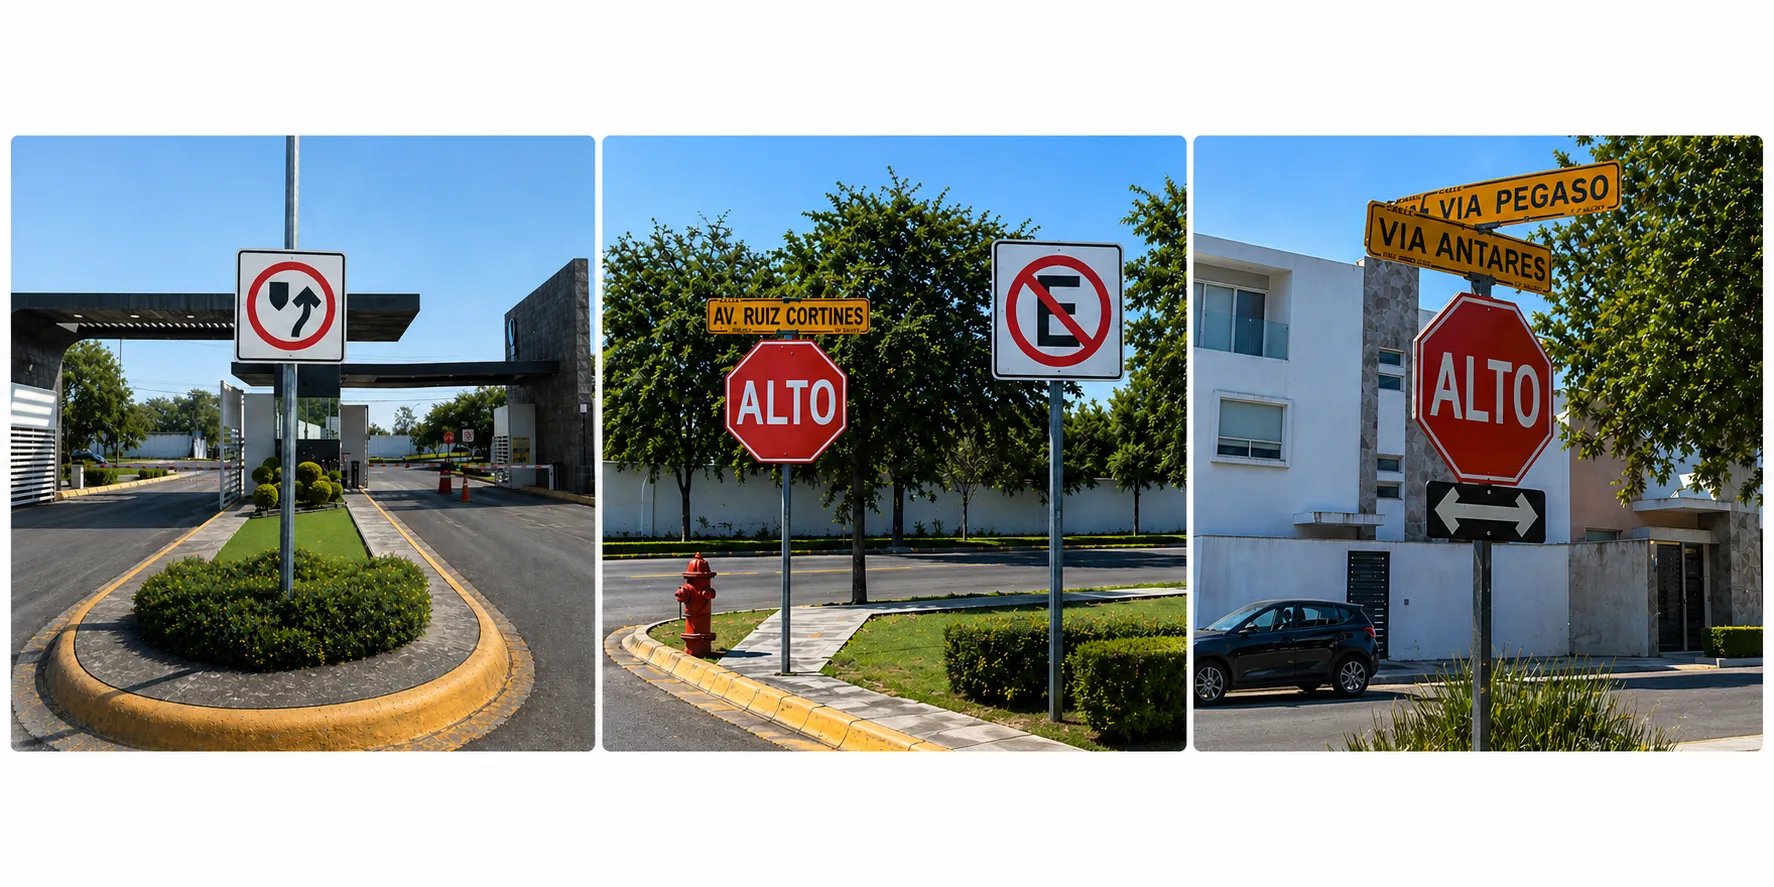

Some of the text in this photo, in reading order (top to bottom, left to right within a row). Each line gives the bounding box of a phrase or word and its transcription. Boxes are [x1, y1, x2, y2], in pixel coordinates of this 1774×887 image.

[1440, 175, 1609, 220] VIA PEGASO
[1379, 218, 1546, 282] VIA ANTARES
[714, 307, 864, 325] AV. RUIZ CORTINES
[1037, 275, 1081, 346] E
[736, 380, 837, 425] ALTO
[1430, 352, 1540, 428] ALTO
